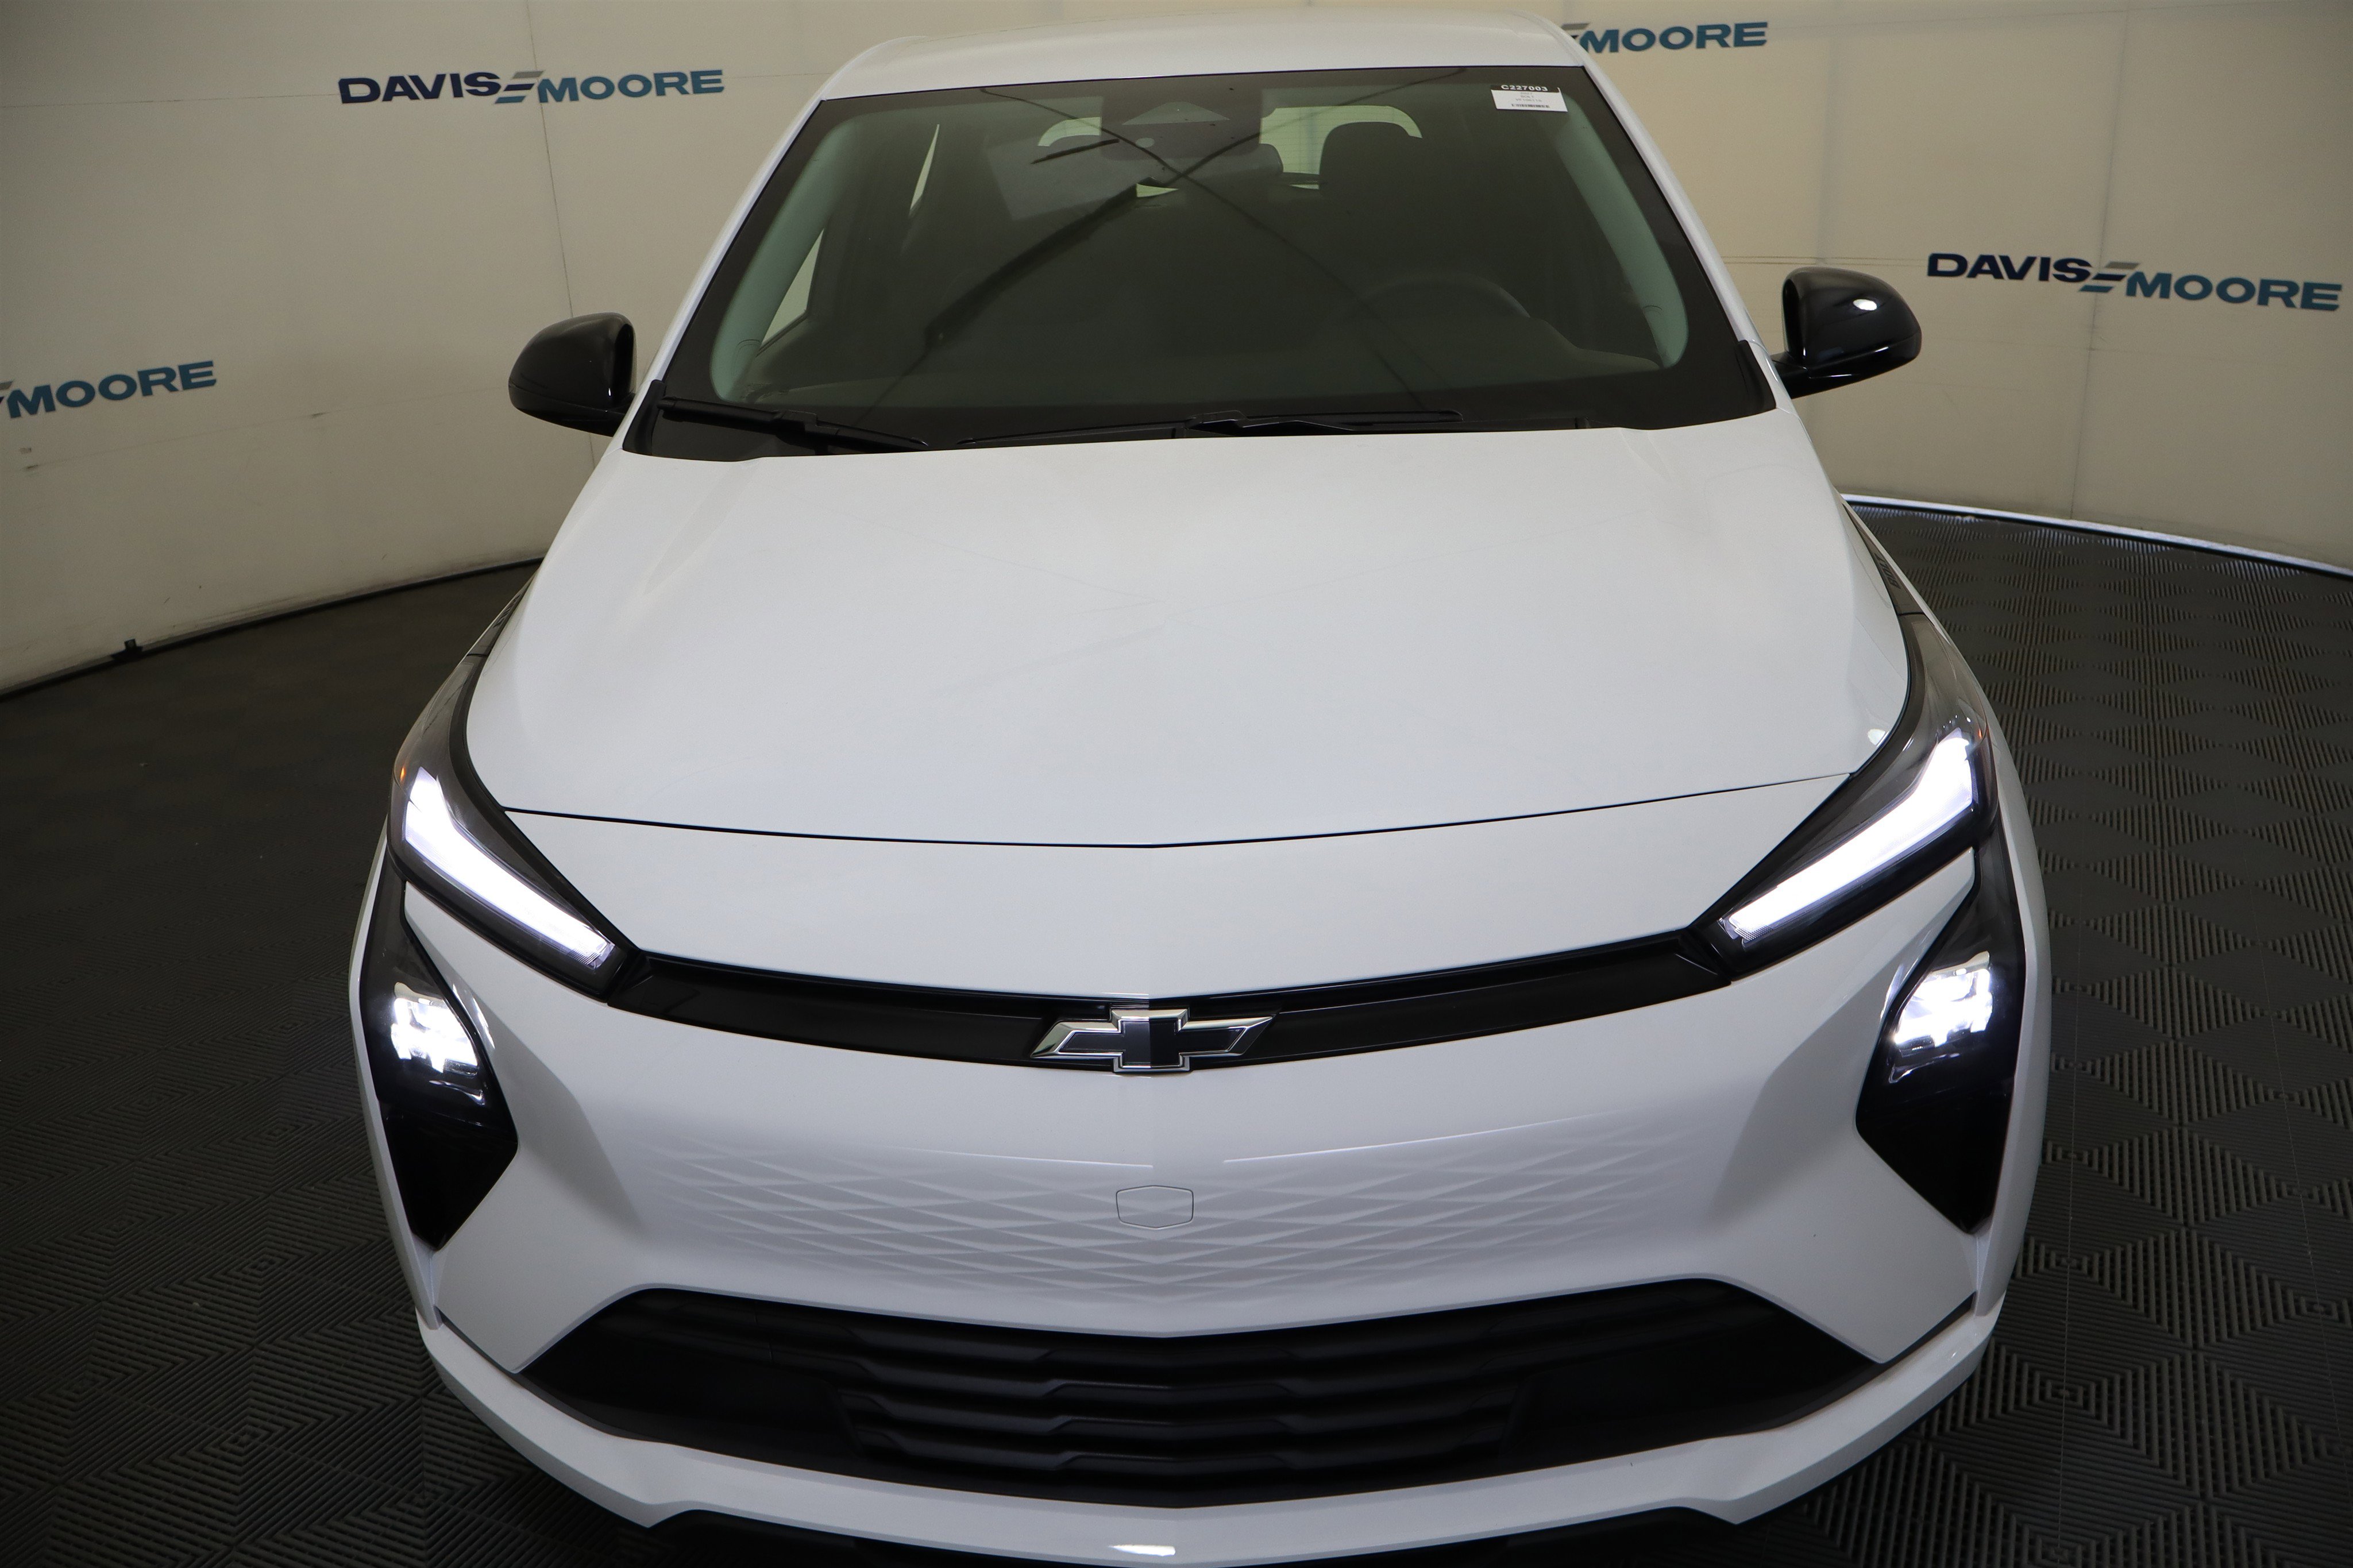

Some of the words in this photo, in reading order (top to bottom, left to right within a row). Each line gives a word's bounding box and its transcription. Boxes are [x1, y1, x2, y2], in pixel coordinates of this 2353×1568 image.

[1579, 21, 1768, 53] MOORE
[338, 72, 501, 104] DAVIS
[537, 69, 724, 103] MOORE
[1927, 253, 2092, 283] DAVIS
[2126, 271, 2343, 311] MOORE
[7, 360, 217, 419] MOORE
